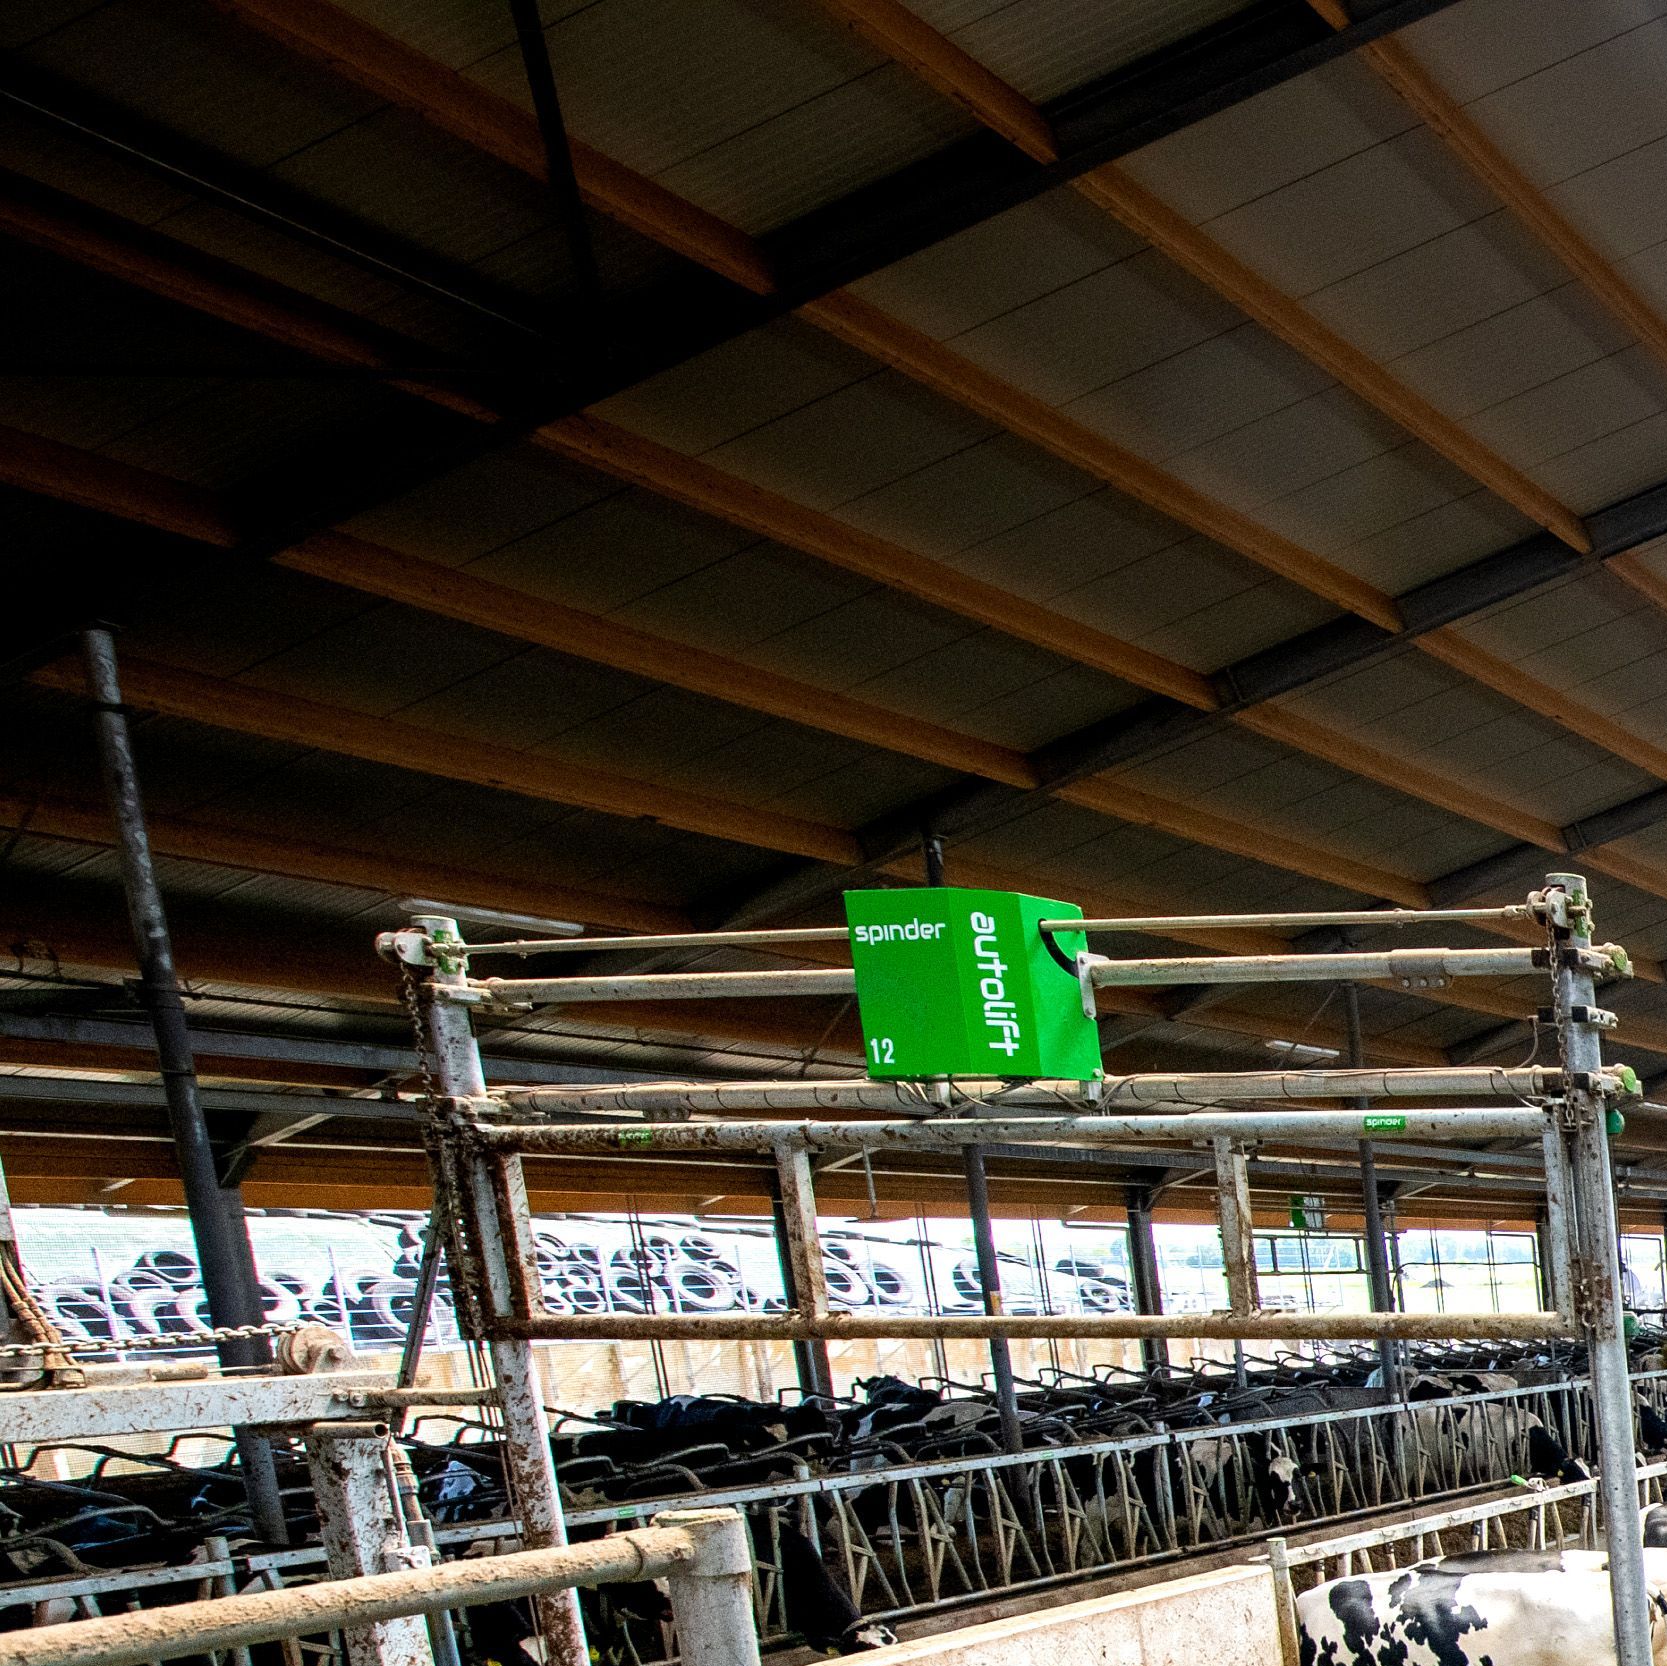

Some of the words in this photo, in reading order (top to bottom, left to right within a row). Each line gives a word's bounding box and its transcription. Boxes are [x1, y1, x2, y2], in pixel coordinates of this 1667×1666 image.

[855, 917, 946, 946] spinder
[970, 911, 1021, 1057] autolift
[870, 1037, 896, 1065] 12
